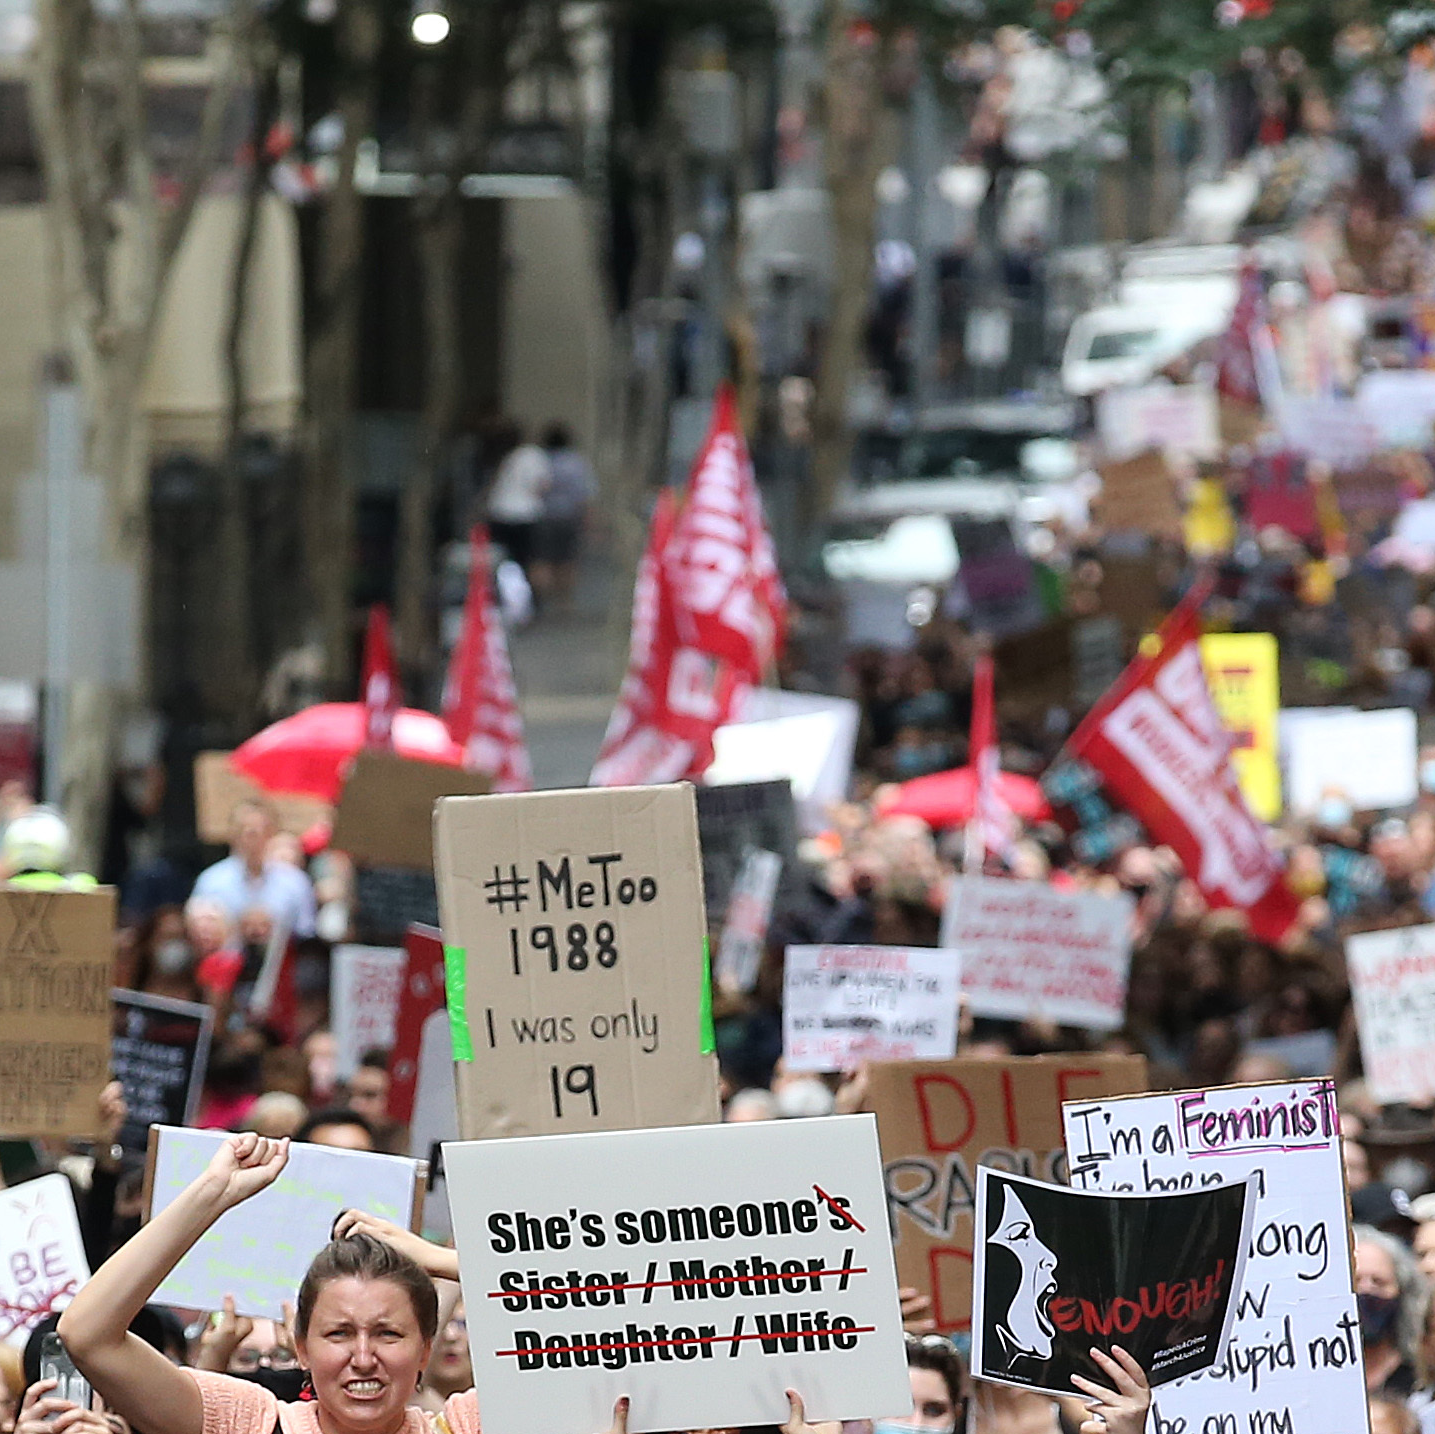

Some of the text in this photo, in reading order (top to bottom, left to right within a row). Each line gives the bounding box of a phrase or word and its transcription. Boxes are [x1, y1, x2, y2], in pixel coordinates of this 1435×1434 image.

[484, 854, 657, 917] #MeToo
[510, 924, 618, 975] 1988
[486, 999, 660, 1055] I was only
[550, 1064, 597, 1119] 19
[1071, 1081, 1339, 1163] I'm a Feminist
[488, 1209, 606, 1254] She's
[11, 1243, 66, 1285] BE
[499, 1270, 630, 1312] Sister
[670, 1255, 826, 1302] Mother
[1047, 1260, 1225, 1334] ENOUGH!
[514, 1323, 716, 1371] Daughter
[755, 1312, 858, 1355] Wife
[1309, 1311, 1358, 1369] not
